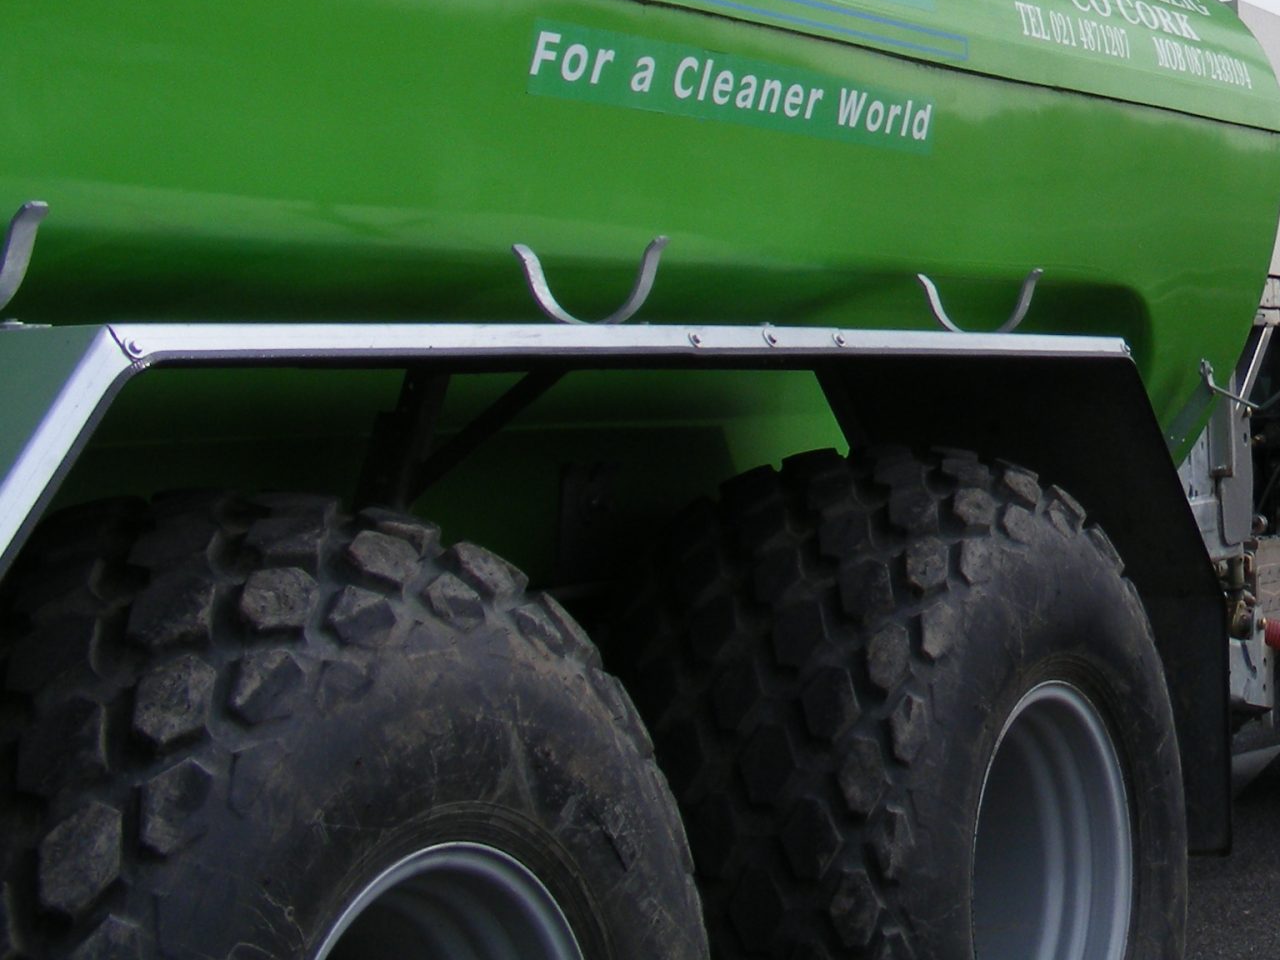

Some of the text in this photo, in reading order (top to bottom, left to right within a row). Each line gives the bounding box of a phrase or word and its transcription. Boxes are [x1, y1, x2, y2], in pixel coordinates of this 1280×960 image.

[1014, 0, 1051, 41] TEL
[1049, 10, 1077, 47] 021
[1152, 36, 1186, 72] MOB
[529, 30, 933, 141] For a Cleaner World
